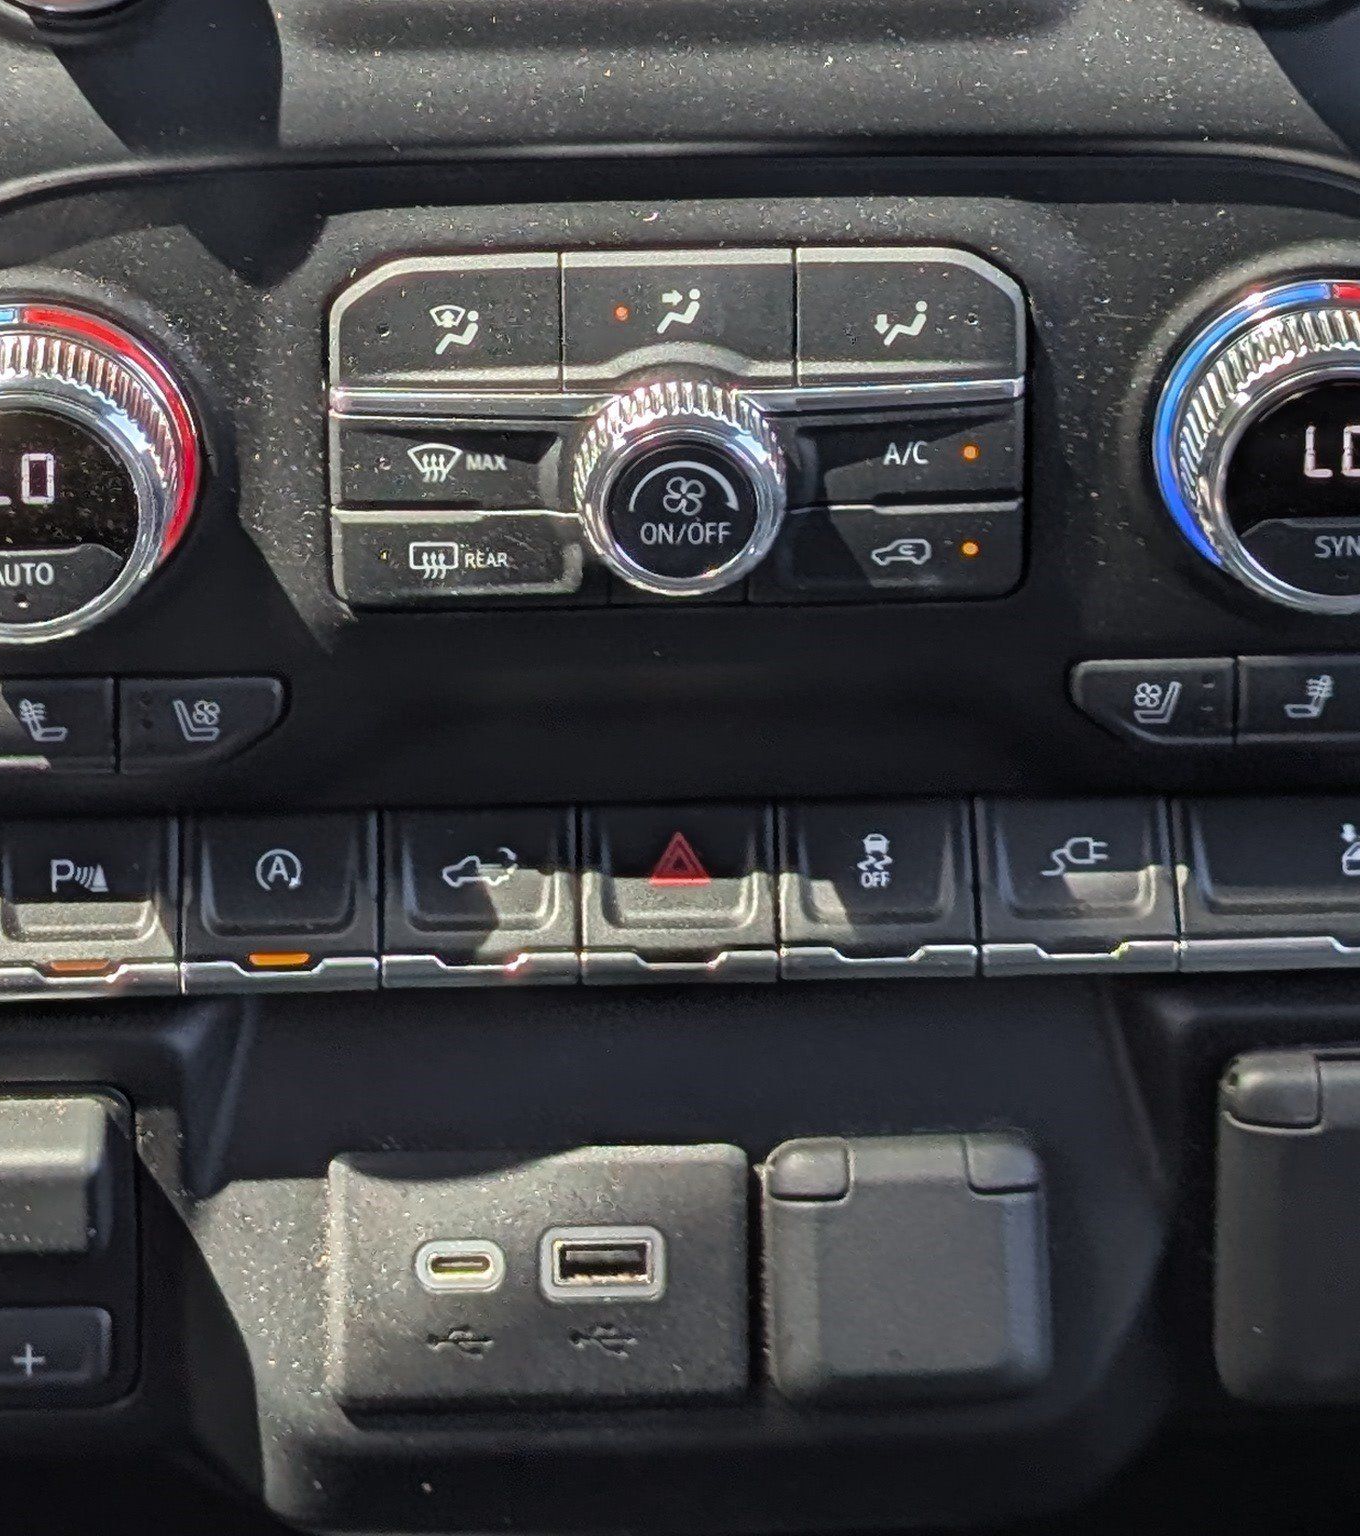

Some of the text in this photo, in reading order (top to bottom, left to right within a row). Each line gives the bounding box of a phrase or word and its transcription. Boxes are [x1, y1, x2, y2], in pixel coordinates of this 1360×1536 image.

[465, 452, 508, 472] MAX
[883, 441, 930, 466] A/C
[640, 520, 732, 546] ON/OFF
[464, 551, 509, 569] REAR
[860, 871, 891, 888] OFF
